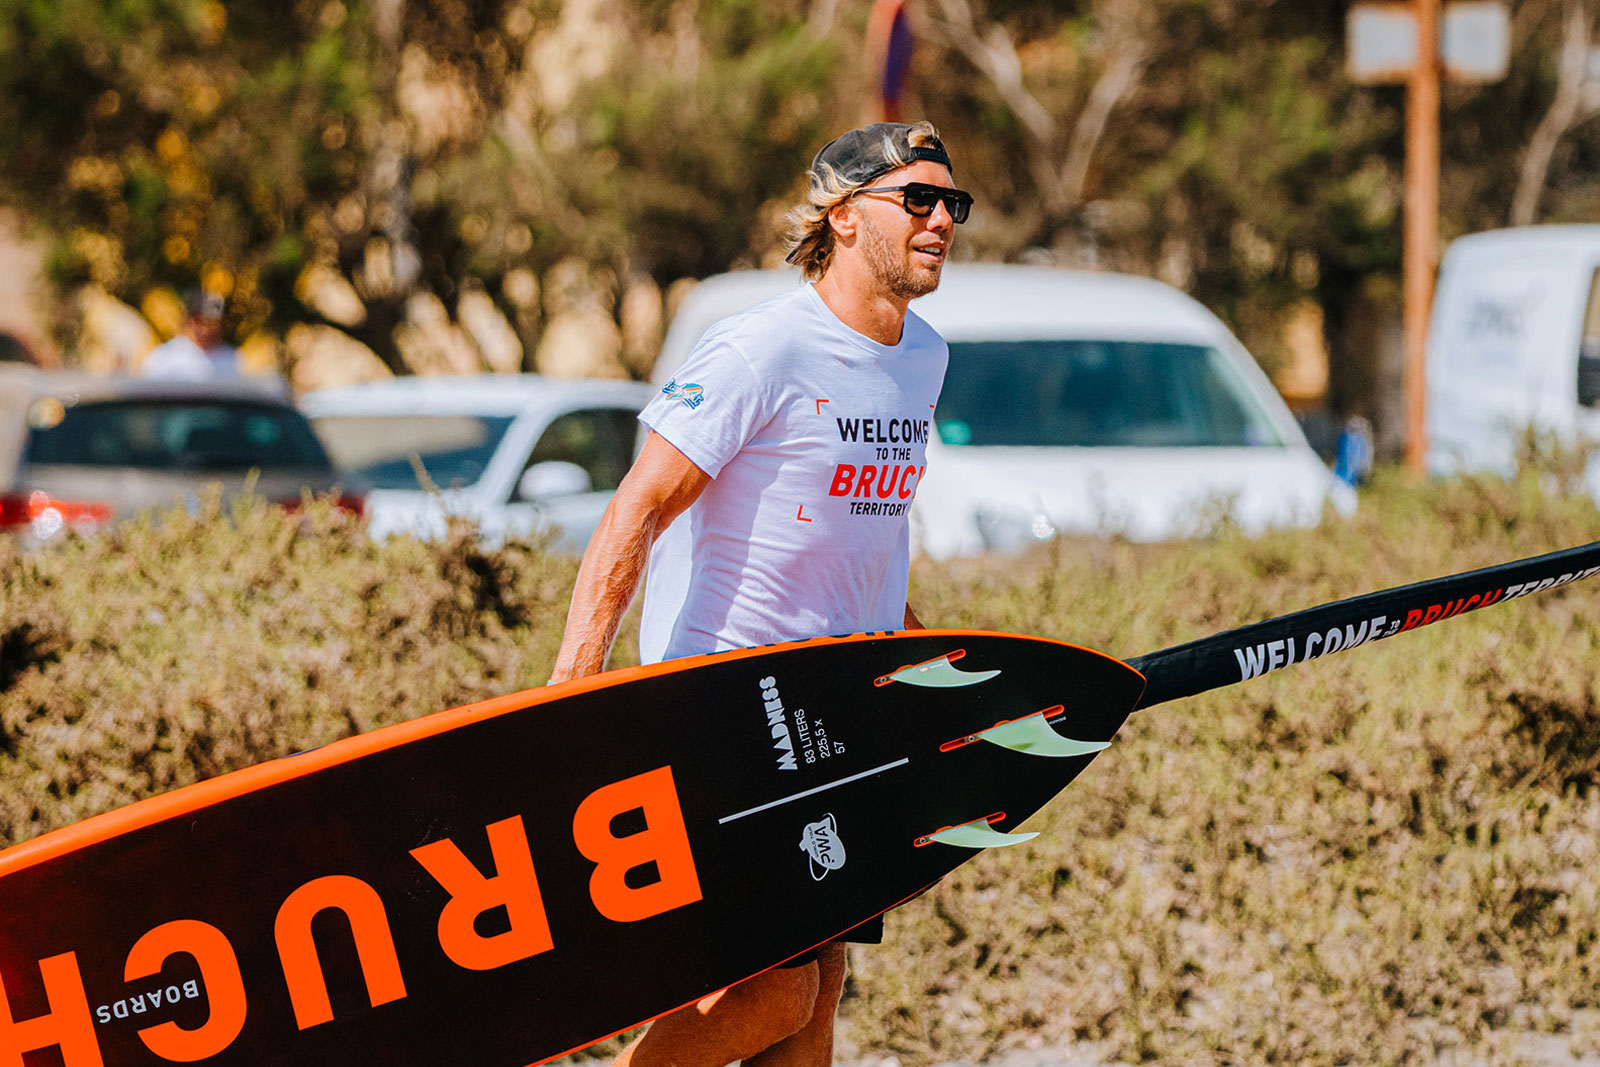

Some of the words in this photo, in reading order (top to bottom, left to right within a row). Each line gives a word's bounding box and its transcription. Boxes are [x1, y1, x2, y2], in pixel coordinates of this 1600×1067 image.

[836, 417, 929, 444] WELCOME
[876, 447, 889, 460] TO
[892, 447, 912, 460] THE
[849, 501, 908, 516] TERRITORY
[1234, 615, 1387, 681] WELCOME
[758, 675, 799, 771] MADNESS
[793, 708, 813, 748] LITERS
[804, 749, 816, 764] 83
[833, 741, 846, 754] 57
[0, 765, 703, 1067] BRUCH
[97, 979, 200, 1024] BOARDS
